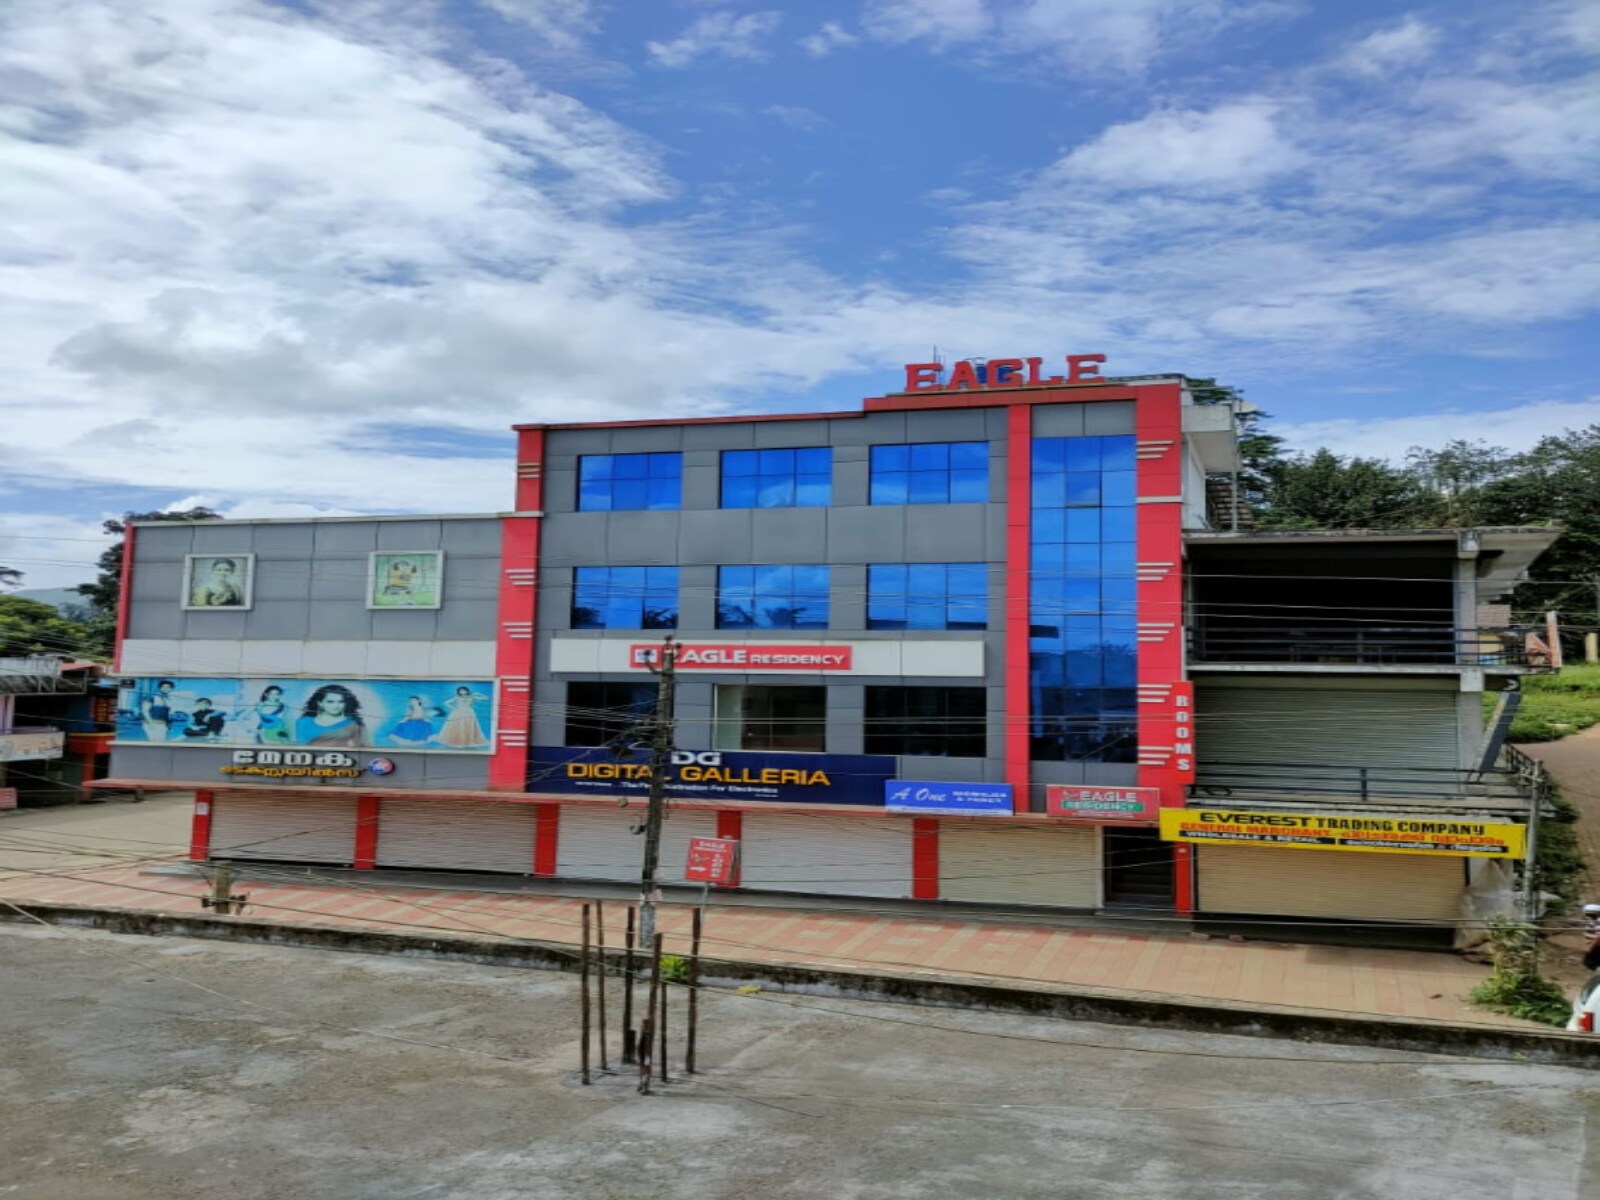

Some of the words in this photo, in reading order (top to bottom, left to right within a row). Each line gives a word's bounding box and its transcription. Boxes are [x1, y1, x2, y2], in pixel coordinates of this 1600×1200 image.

[905, 354, 1107, 392] EAGLE
[666, 649, 747, 663] AGLE
[751, 654, 844, 665] RESIDENCY
[1175, 695, 1192, 771] ROOMS
[671, 751, 721, 765] DG
[680, 766, 830, 785] GALLERIA
[1080, 790, 1137, 803] EAGLE
[1200, 812, 1312, 827] EVEREST
[1316, 817, 1393, 832] TRADING
[1397, 822, 1485, 836] COMPANY
